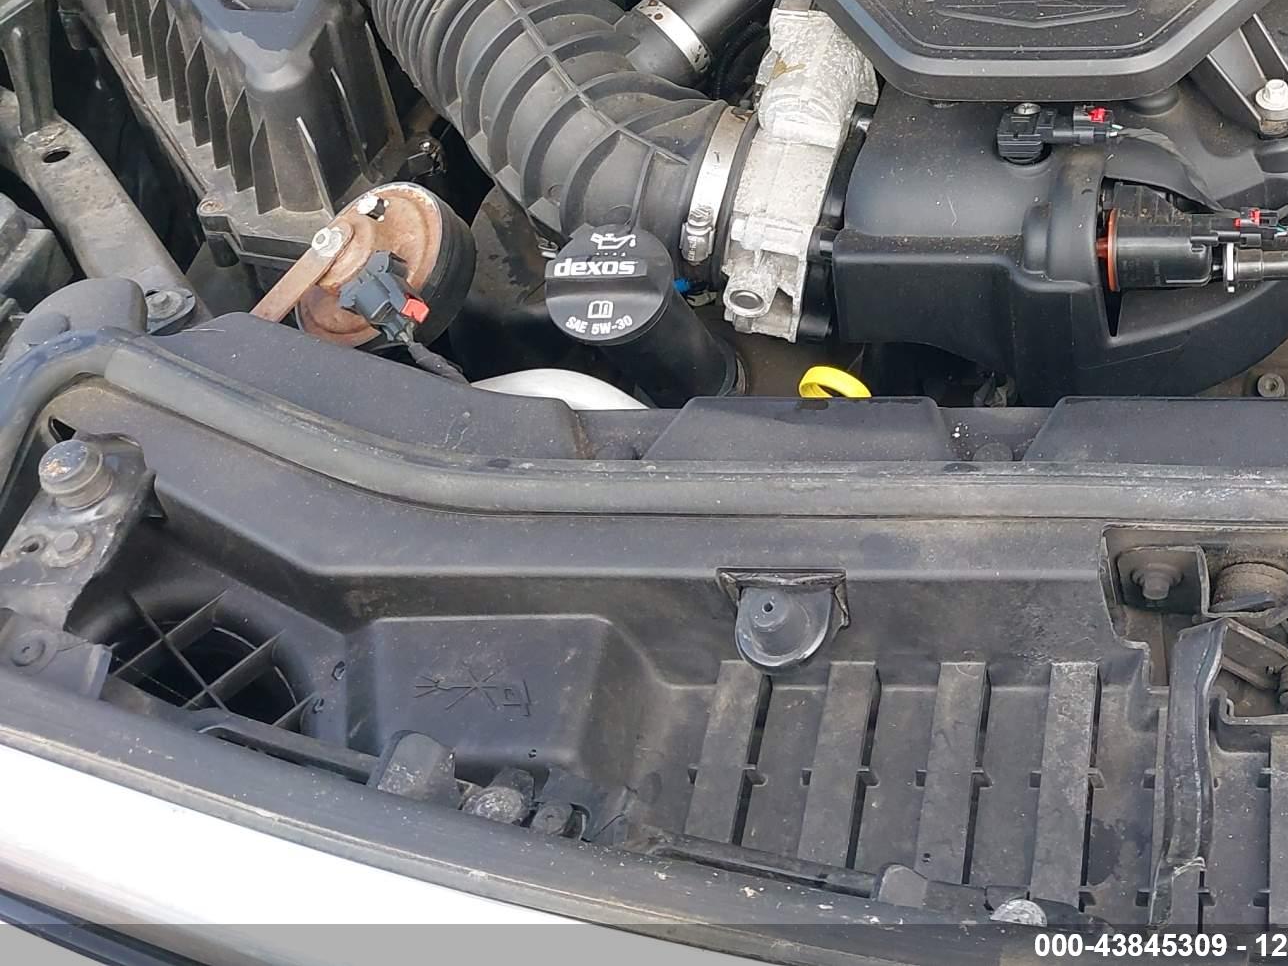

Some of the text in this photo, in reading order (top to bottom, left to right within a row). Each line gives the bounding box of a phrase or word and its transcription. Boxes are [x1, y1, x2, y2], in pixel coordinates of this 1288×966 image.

[553, 257, 639, 277] dexos
[565, 315, 633, 335] SAE 5W-30
